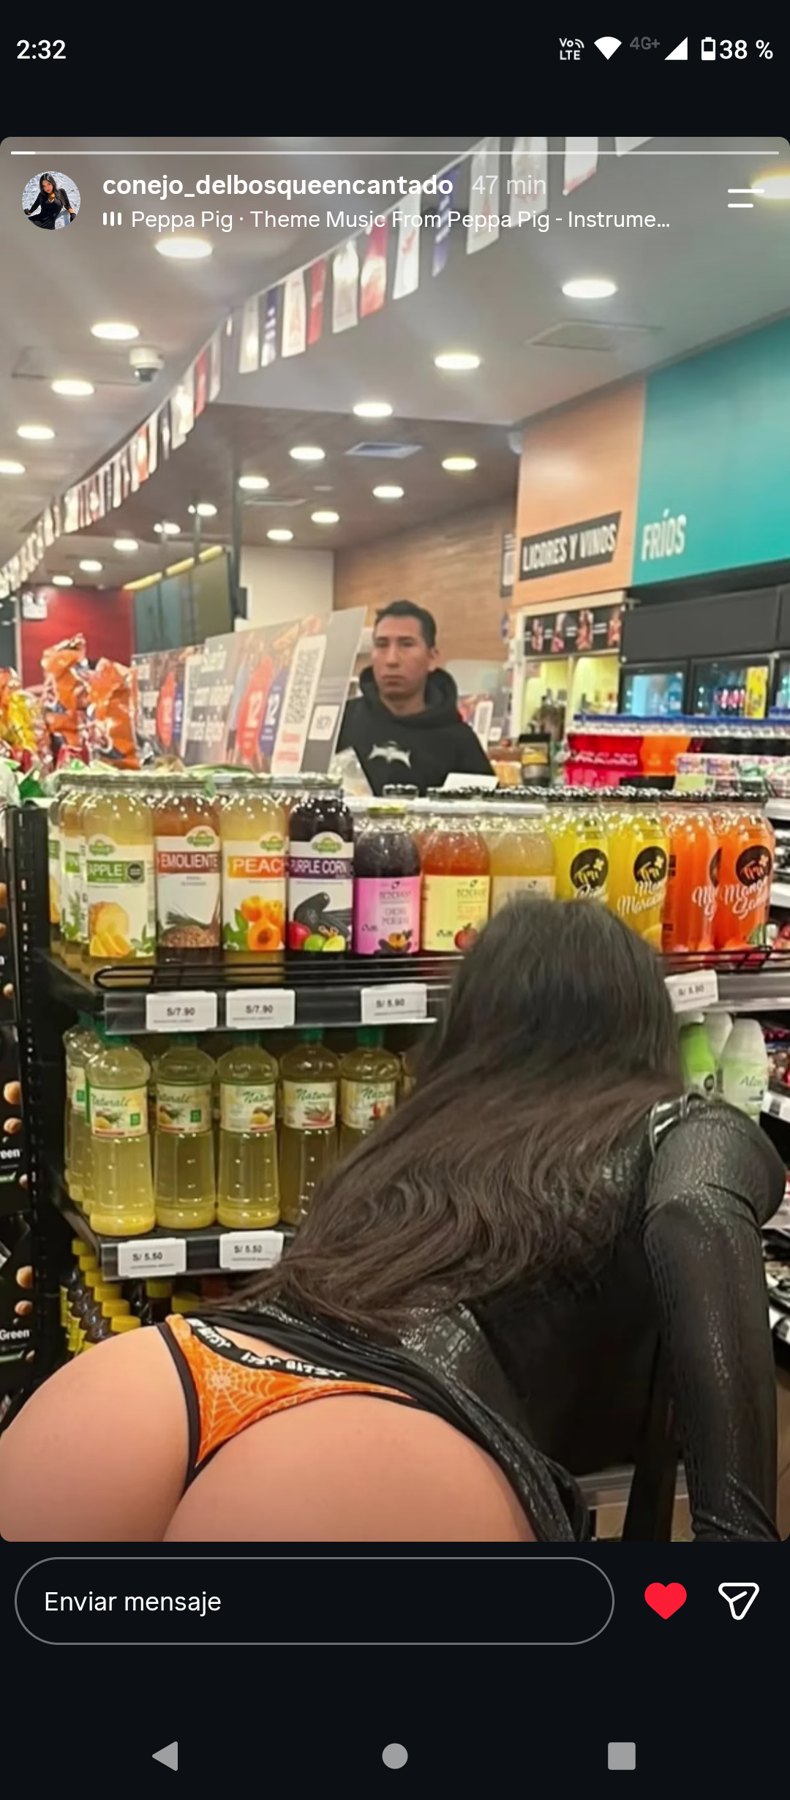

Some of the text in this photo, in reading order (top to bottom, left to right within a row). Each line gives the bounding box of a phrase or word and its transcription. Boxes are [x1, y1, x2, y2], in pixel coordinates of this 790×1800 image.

[641, 508, 687, 561] FRÍOS
[522, 523, 617, 571] LICORES Y VINOS
[160, 854, 218, 868] EMOLIENTE
[167, 1007, 195, 1016] S/7.90
[245, 1004, 273, 1014] S/7.90
[0, 1329, 30, 1340] Green
